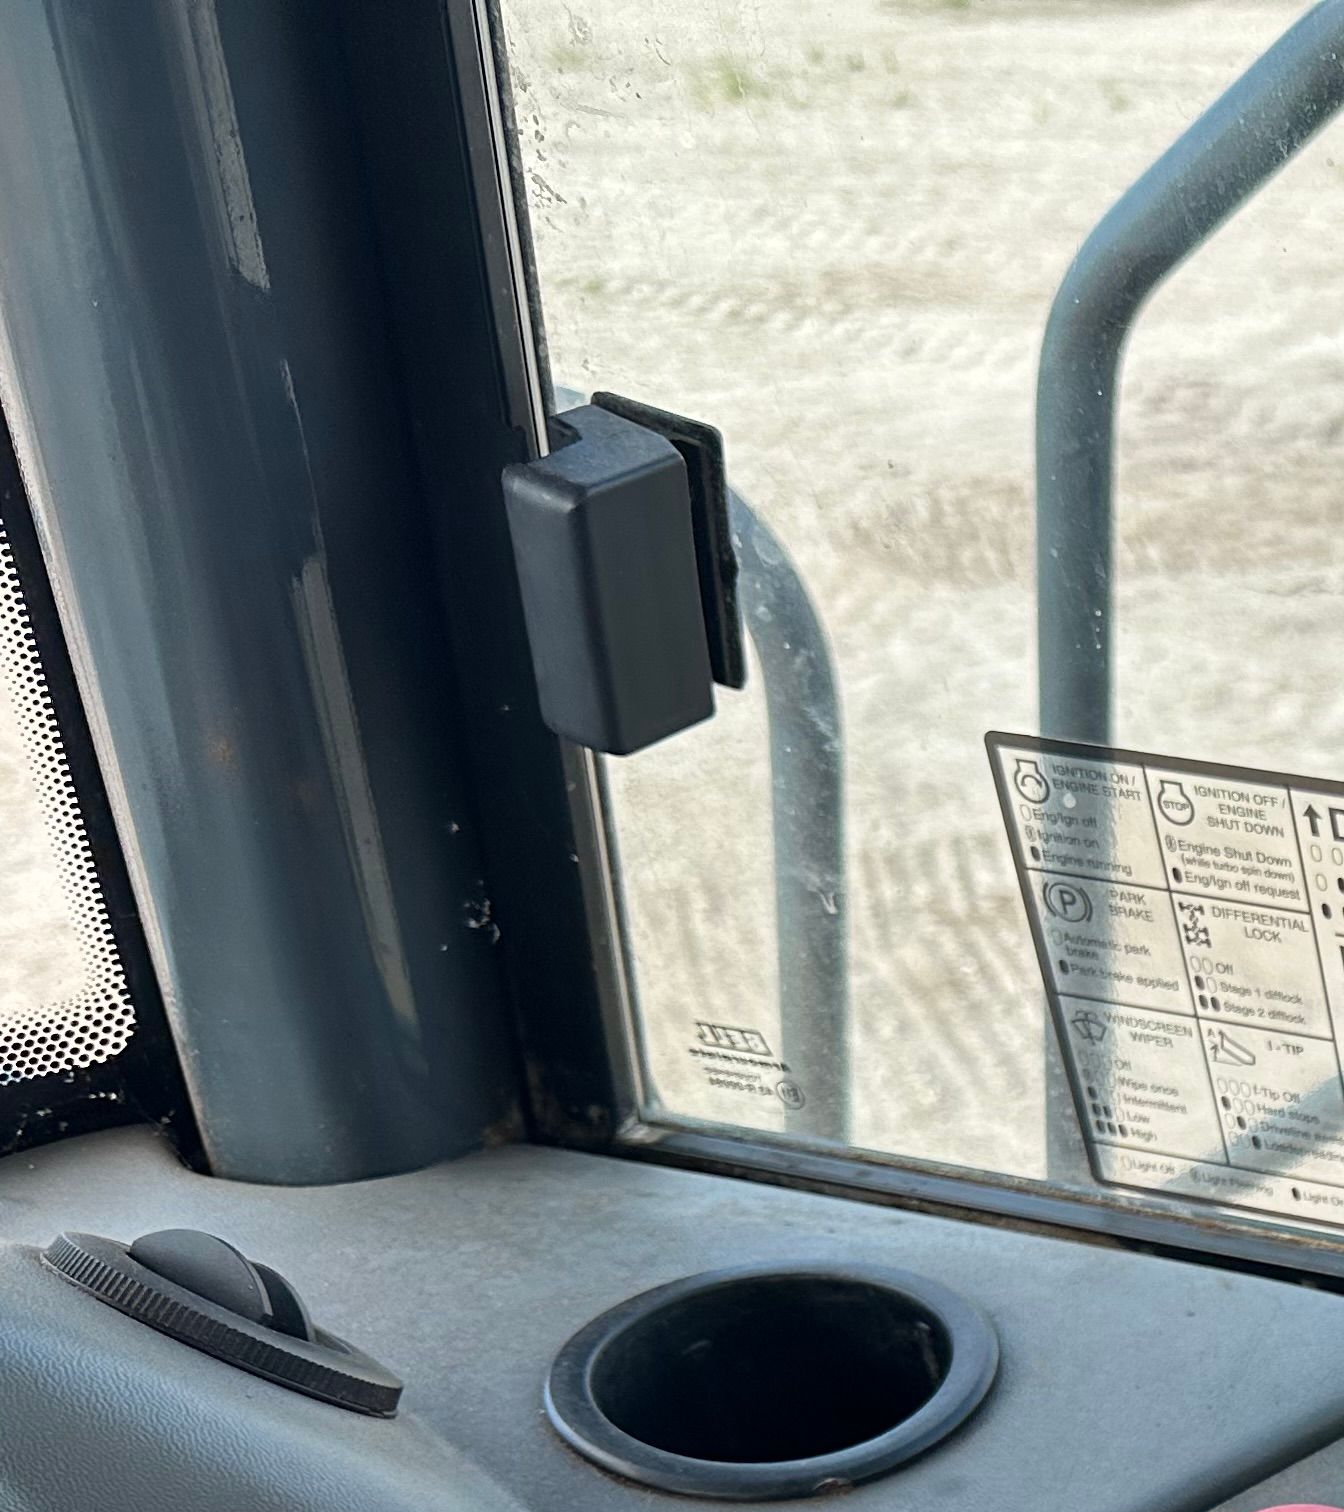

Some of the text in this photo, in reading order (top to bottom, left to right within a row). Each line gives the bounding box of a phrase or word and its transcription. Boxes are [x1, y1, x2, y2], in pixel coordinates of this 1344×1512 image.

[1163, 800, 1190, 811] STOP
[1194, 785, 1278, 807] IGNITION OFF
[1219, 804, 1267, 821] ENGINE
[1207, 816, 1285, 838] SHUT DOWN
[1211, 905, 1309, 933] DIFFERENTIAL
[1244, 926, 1282, 943] LOCK
